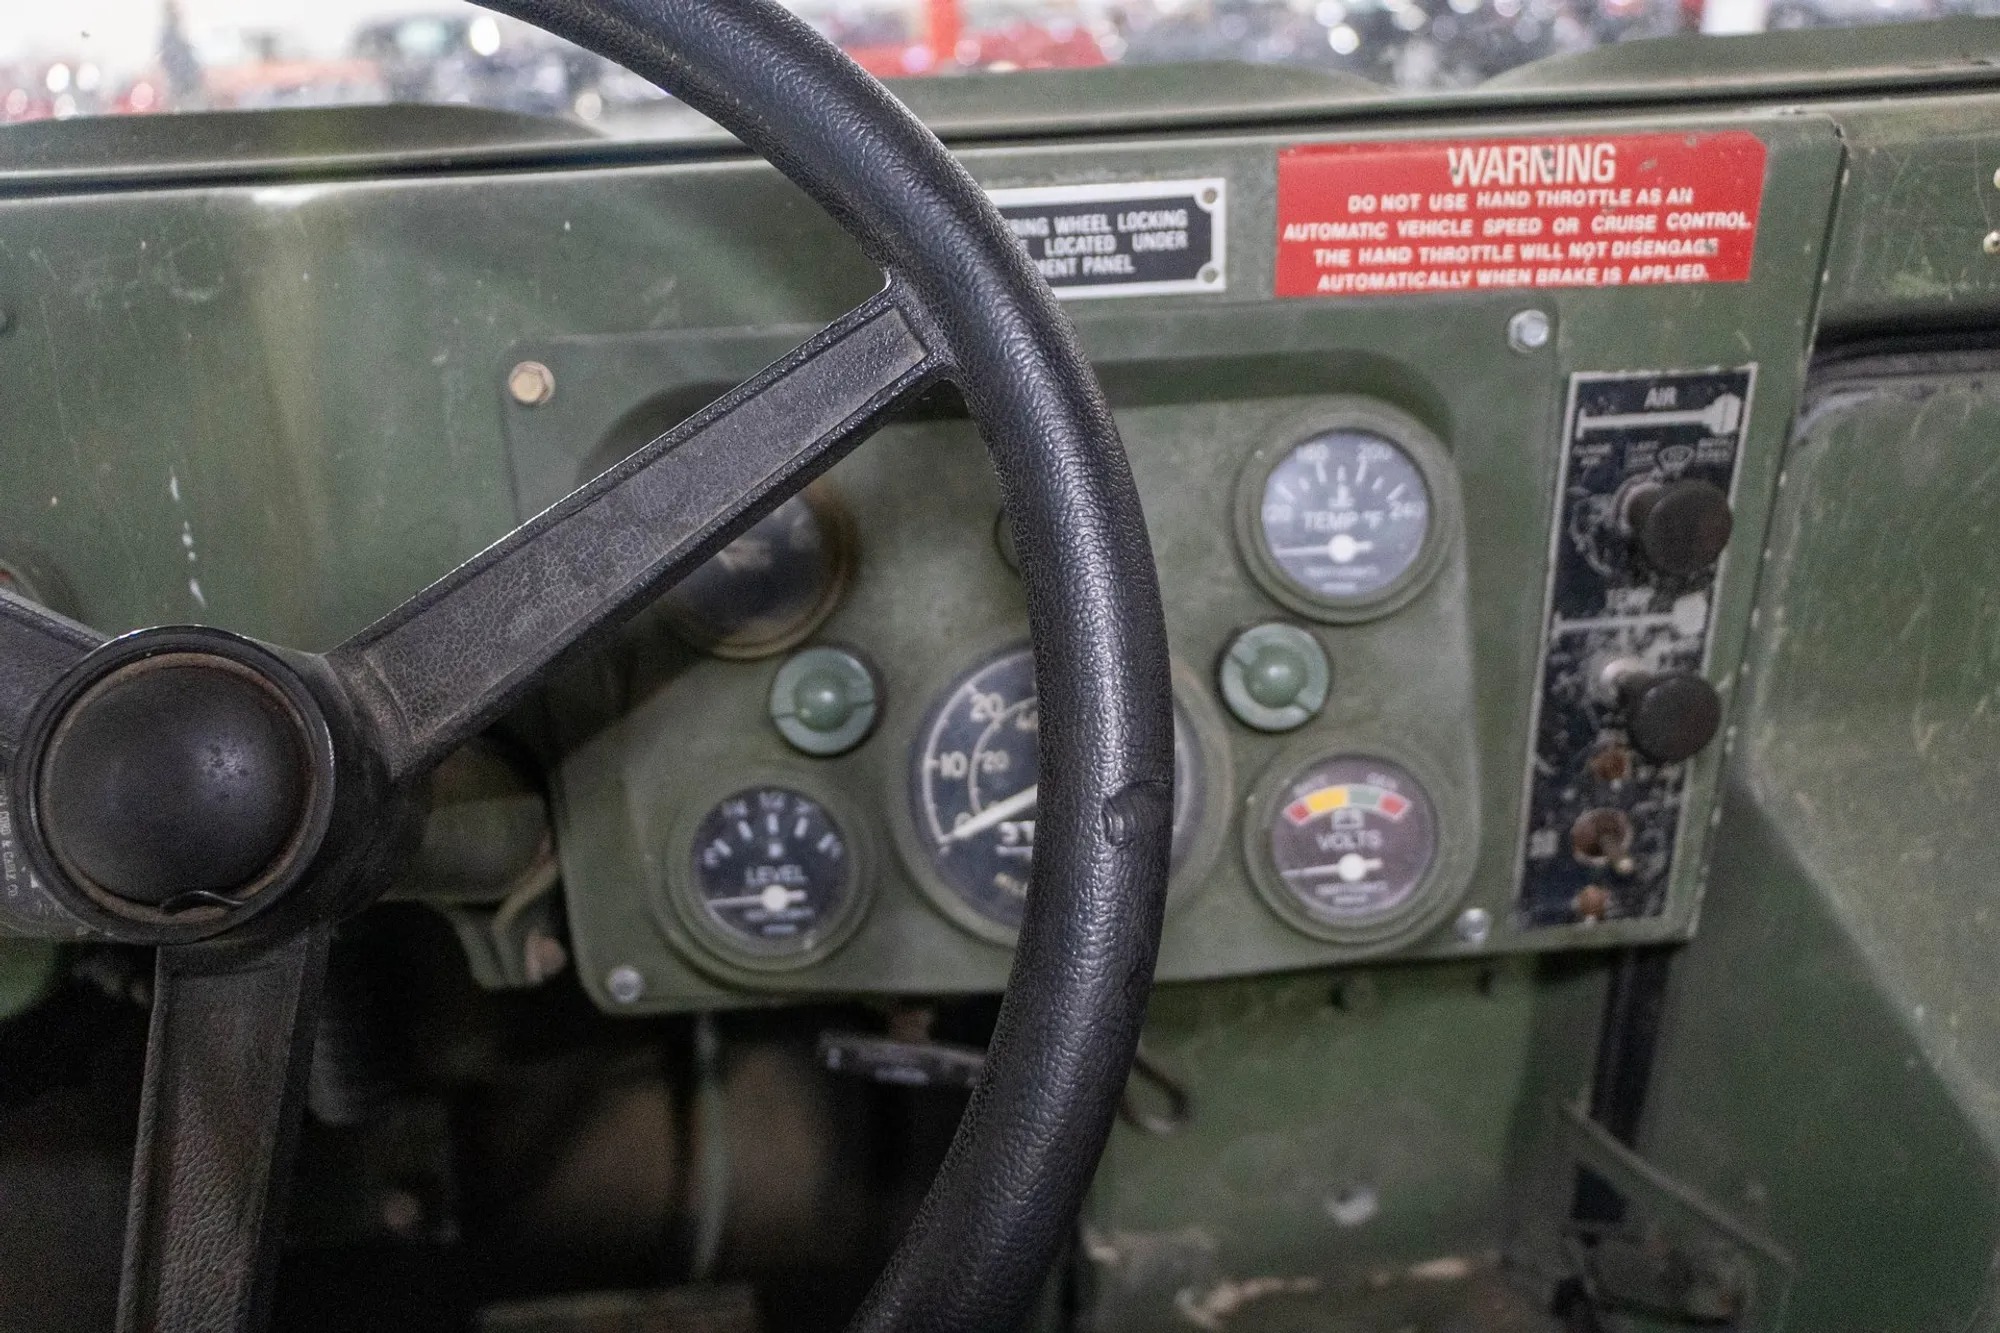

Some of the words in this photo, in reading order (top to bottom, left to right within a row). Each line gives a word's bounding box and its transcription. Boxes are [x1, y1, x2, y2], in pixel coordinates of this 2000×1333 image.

[1448, 143, 1616, 186] WARNING
[1348, 194, 1377, 213] DO
[1381, 193, 1420, 213] NOT
[1428, 192, 1468, 212] USE
[1476, 190, 1529, 210] HAND
[1536, 188, 1632, 209] THROTTLE
[1636, 188, 1663, 206] AS
[1666, 186, 1694, 205] AN
[1053, 213, 1111, 235] WHEEL
[1117, 209, 1188, 232] LOCKING
[1283, 220, 1388, 242] AUTOMATIC
[1398, 218, 1473, 239] VEHICLE
[1483, 217, 1542, 237] SPEED
[1552, 216, 1580, 235] OR
[1591, 214, 1657, 234] CRUISE
[1666, 211, 1753, 231] CONTROL.
[1044, 234, 1117, 258] LOCATED
[1132, 231, 1188, 252] UNDER
[1314, 247, 1350, 267] THE
[1358, 245, 1413, 266] HAND
[1418, 243, 1516, 264] THROTTLE
[1520, 241, 1564, 261] WILL
[1568, 240, 1609, 260] NOT
[1316, 269, 1471, 293] AUTOMATICALLY
[1475, 267, 1532, 288] WHEN
[1535, 266, 1599, 287] BRAKE
[1602, 265, 1623, 285] IS
[1628, 263, 1709, 284] APPLIED.
[1644, 387, 1676, 406] AIR
[1304, 510, 1359, 531] TEMP
[971, 692, 1004, 720] 20
[940, 750, 968, 778] 10
[1315, 829, 1384, 850] VOLTS
